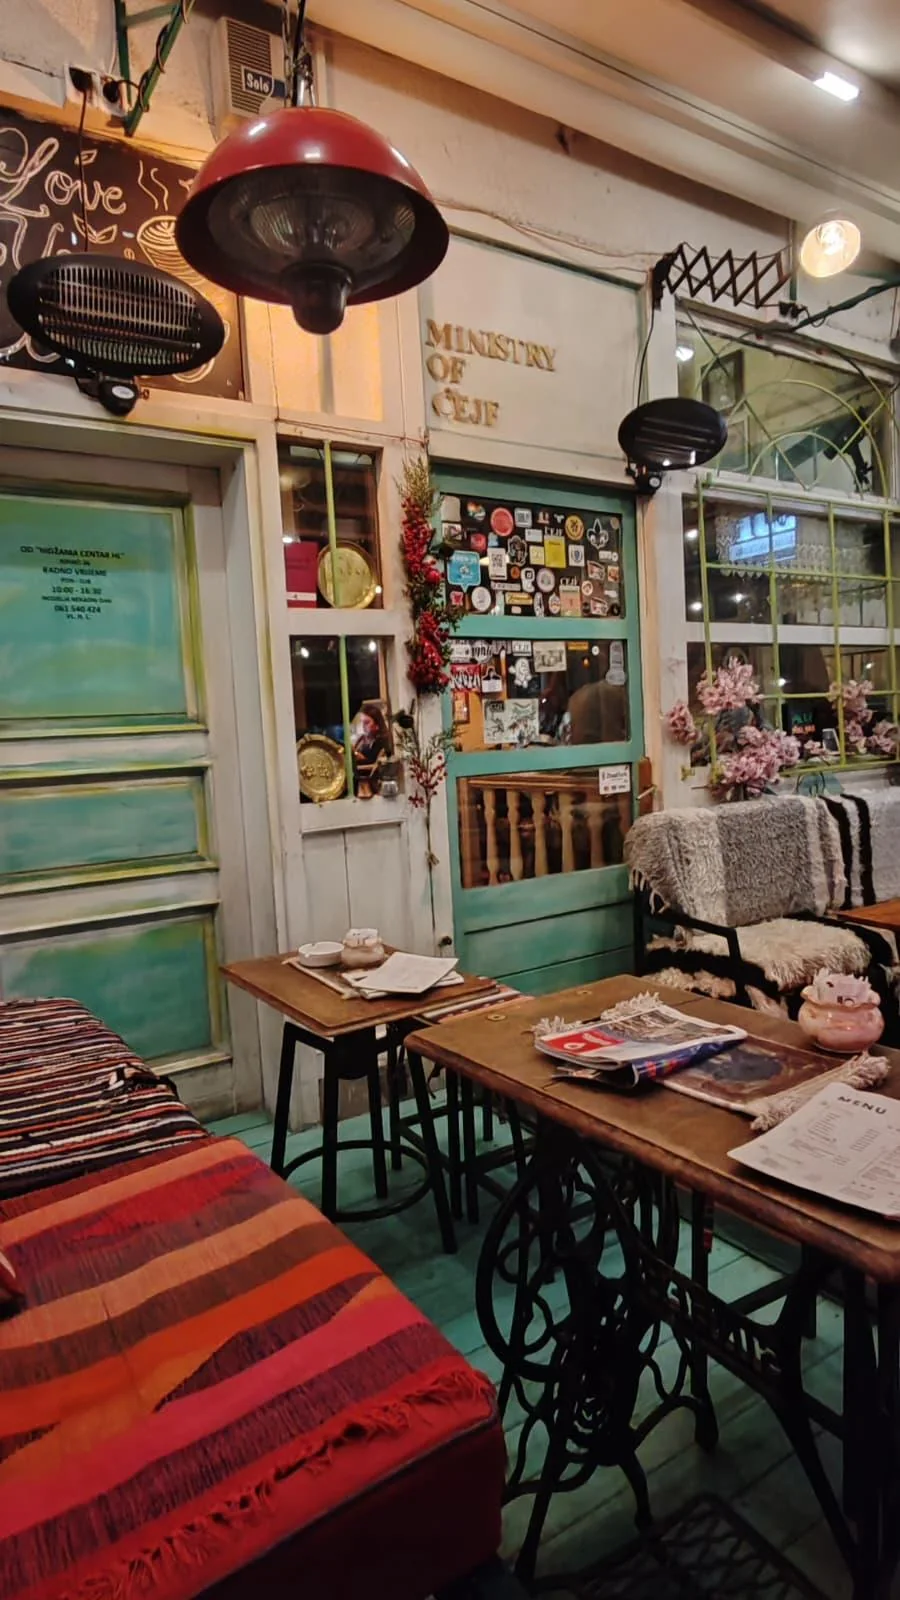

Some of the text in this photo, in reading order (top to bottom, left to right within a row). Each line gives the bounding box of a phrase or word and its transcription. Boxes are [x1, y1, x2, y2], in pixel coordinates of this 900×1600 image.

[246, 72, 269, 93] Solo
[0, 127, 127, 218] Love
[425, 318, 557, 372] MINISTRY
[426, 353, 466, 384] OF
[42, 566, 107, 577] RADNO VRIJEME
[837, 1096, 887, 1115] MENU
